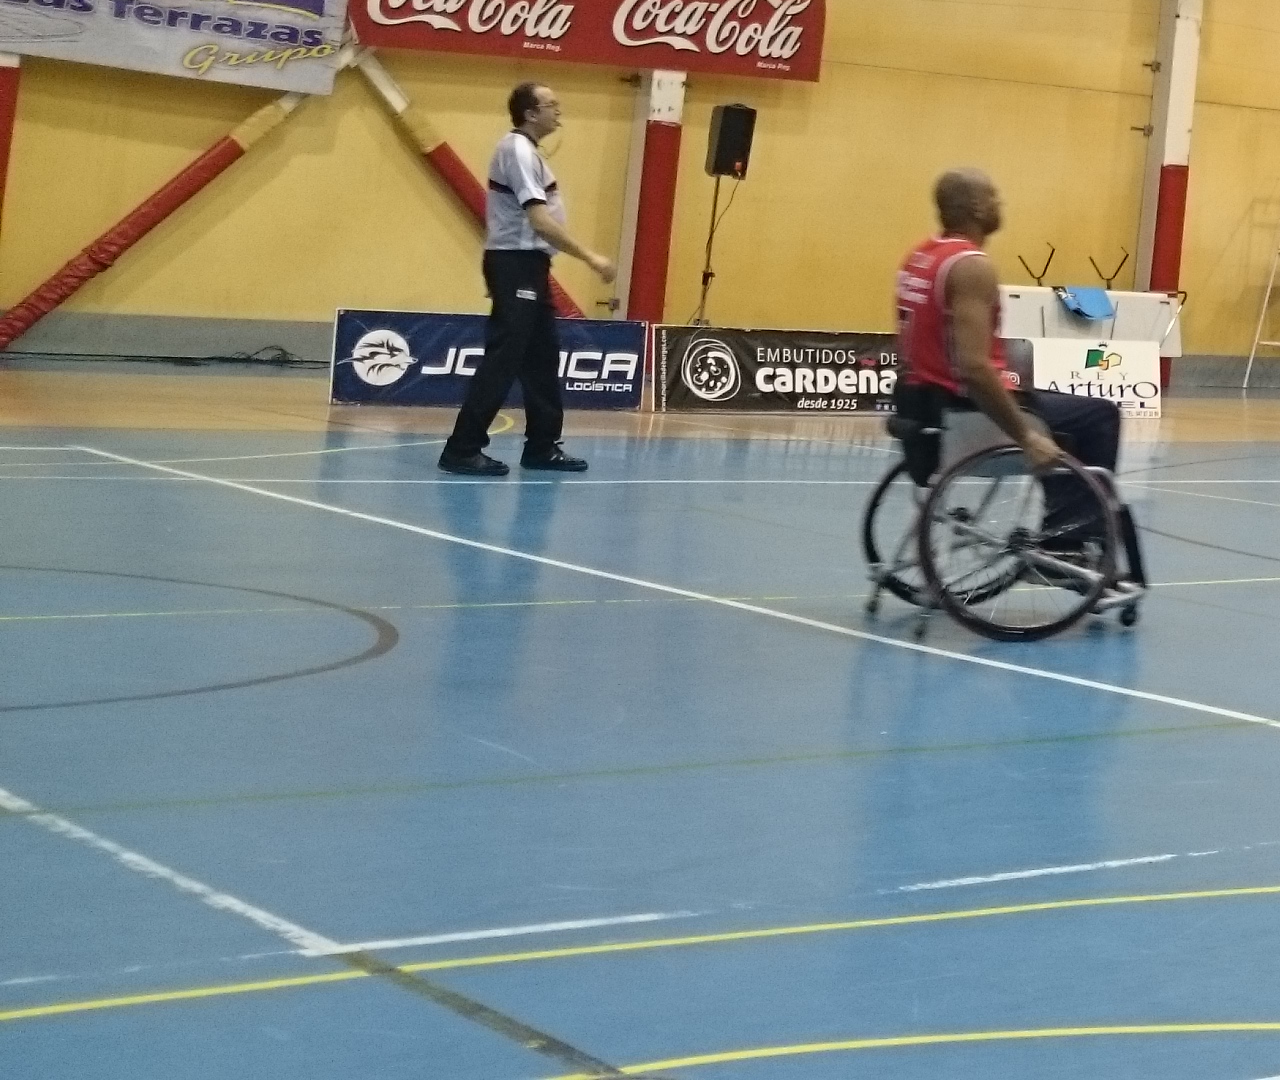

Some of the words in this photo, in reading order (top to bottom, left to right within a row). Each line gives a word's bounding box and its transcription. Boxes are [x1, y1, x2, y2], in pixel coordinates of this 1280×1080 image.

[182, 44, 335, 75] Grupo
[757, 347, 857, 365] EMBUTIDOS
[880, 352, 898, 366] DE
[565, 380, 633, 392] LOGÍSTICA
[797, 397, 828, 410] desde
[829, 399, 858, 410] 1925
